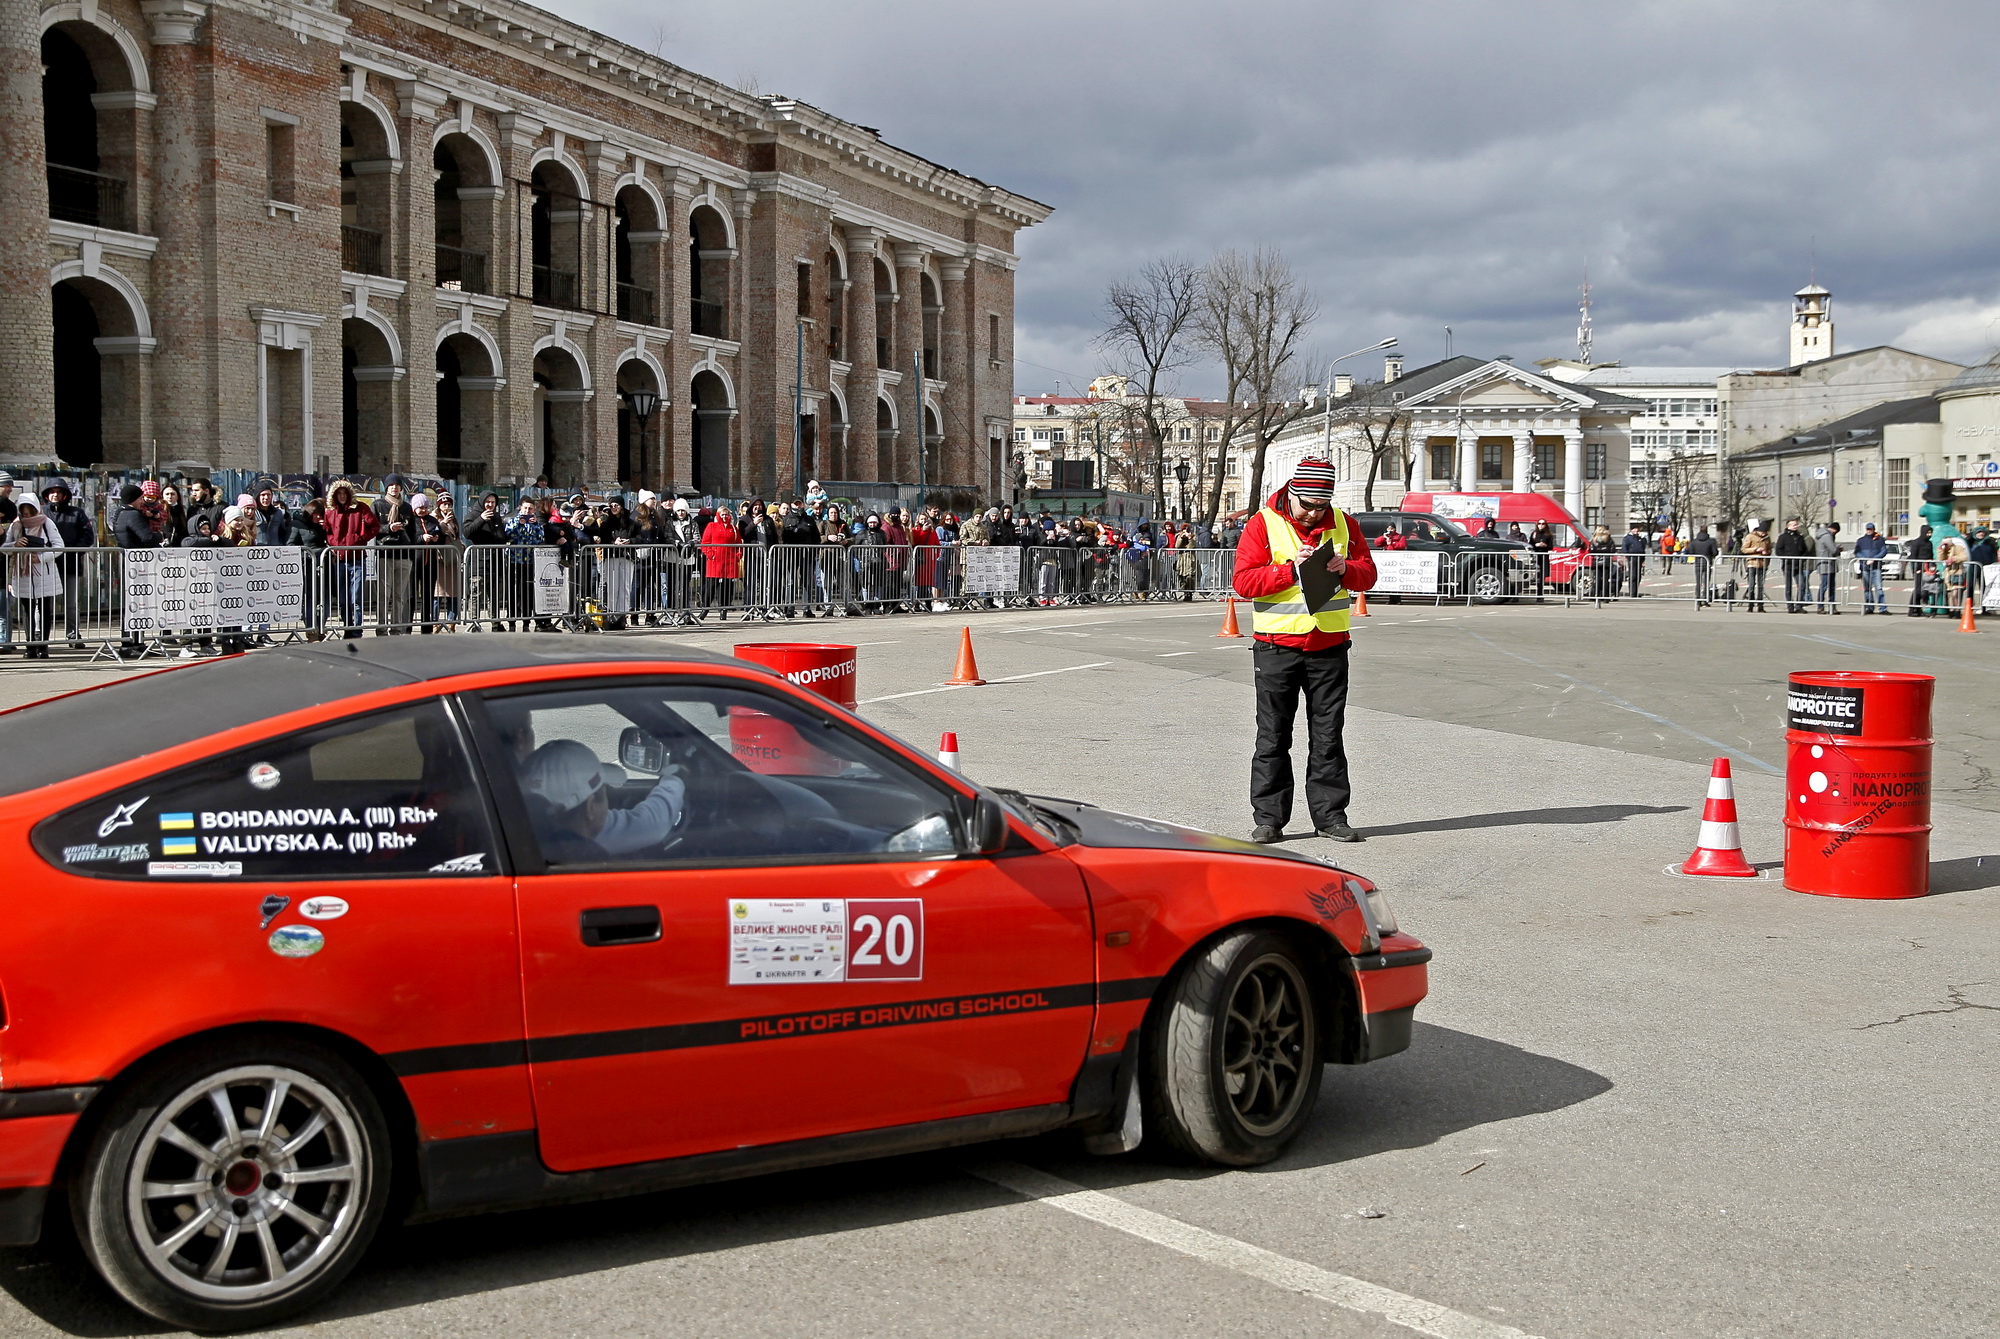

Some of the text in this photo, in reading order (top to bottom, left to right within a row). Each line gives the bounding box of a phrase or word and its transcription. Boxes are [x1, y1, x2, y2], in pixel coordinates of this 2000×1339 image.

[1852, 772, 1891, 780] продукт
[201, 806, 439, 829] BOHDANOVA A. (III) Rh+
[1821, 799, 1892, 858] NANOPROTEC
[64, 843, 98, 854] UNITED
[203, 831, 417, 854] VALUYSKA A. (II) Rh+
[119, 852, 151, 862] SERIES
[1323, 891, 1353, 918] ROKS
[733, 924, 843, 935] ВЕЛИКЕ ЖІНОЧЕ РАЛІ
[852, 914, 915, 966] 20
[740, 993, 1049, 1038] PILOTOFF DRIVING SCHOOL
